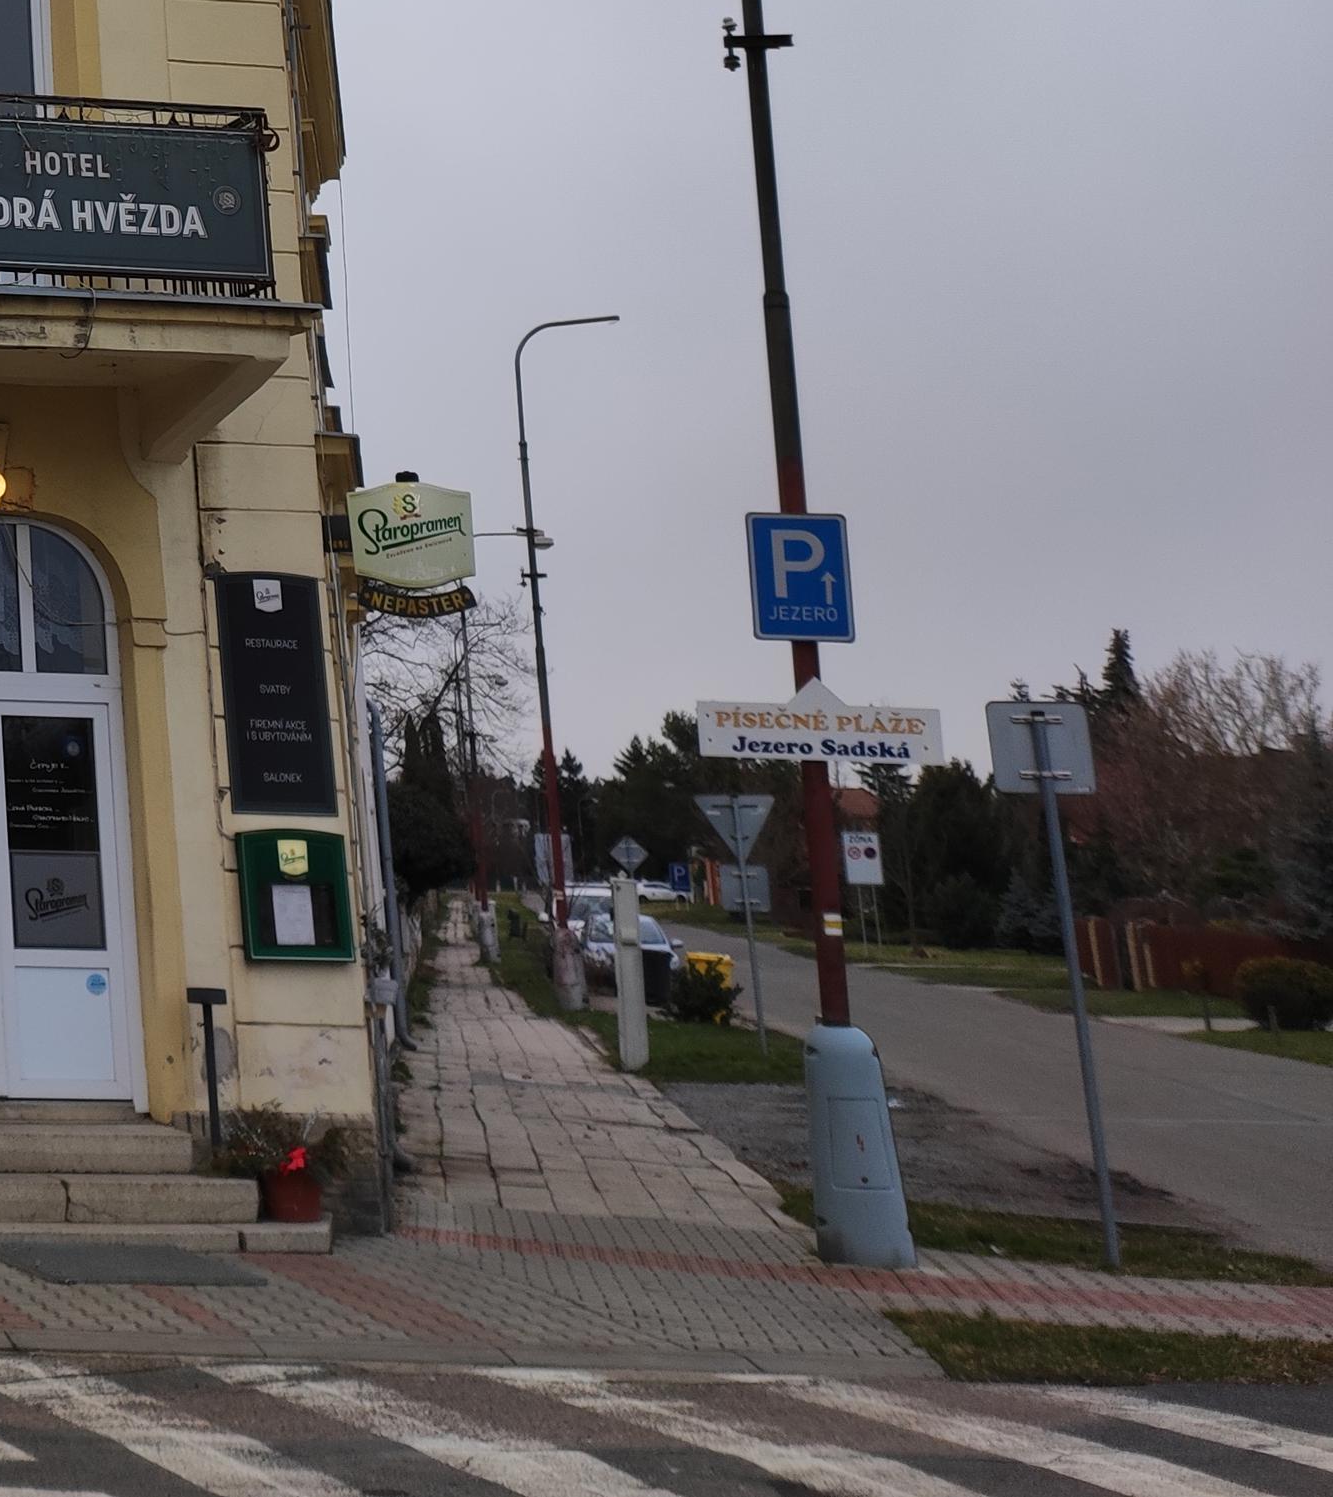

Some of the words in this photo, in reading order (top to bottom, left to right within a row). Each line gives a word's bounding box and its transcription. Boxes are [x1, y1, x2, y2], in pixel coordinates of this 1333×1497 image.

[25, 150, 111, 179] HOTEL
[71, 192, 208, 238] HVĚZDA
[358, 509, 466, 555] Staropramen
[770, 529, 825, 598] P
[371, 590, 465, 615] NEPASTER
[768, 606, 837, 622] JEZERO
[245, 638, 298, 649] RESTAURACE
[259, 684, 291, 695] SVATBY
[250, 718, 284, 729] FIREMNÍ
[285, 720, 307, 730] AKCE
[715, 706, 829, 731] PÍSEČNÉ
[835, 711, 926, 735] PLÁŽE
[258, 731, 312, 742] UBYTOVÁNÍM
[733, 736, 813, 754] Jezero
[821, 738, 910, 759] Sadská
[263, 772, 301, 783] SALONEK
[673, 866, 686, 881] P
